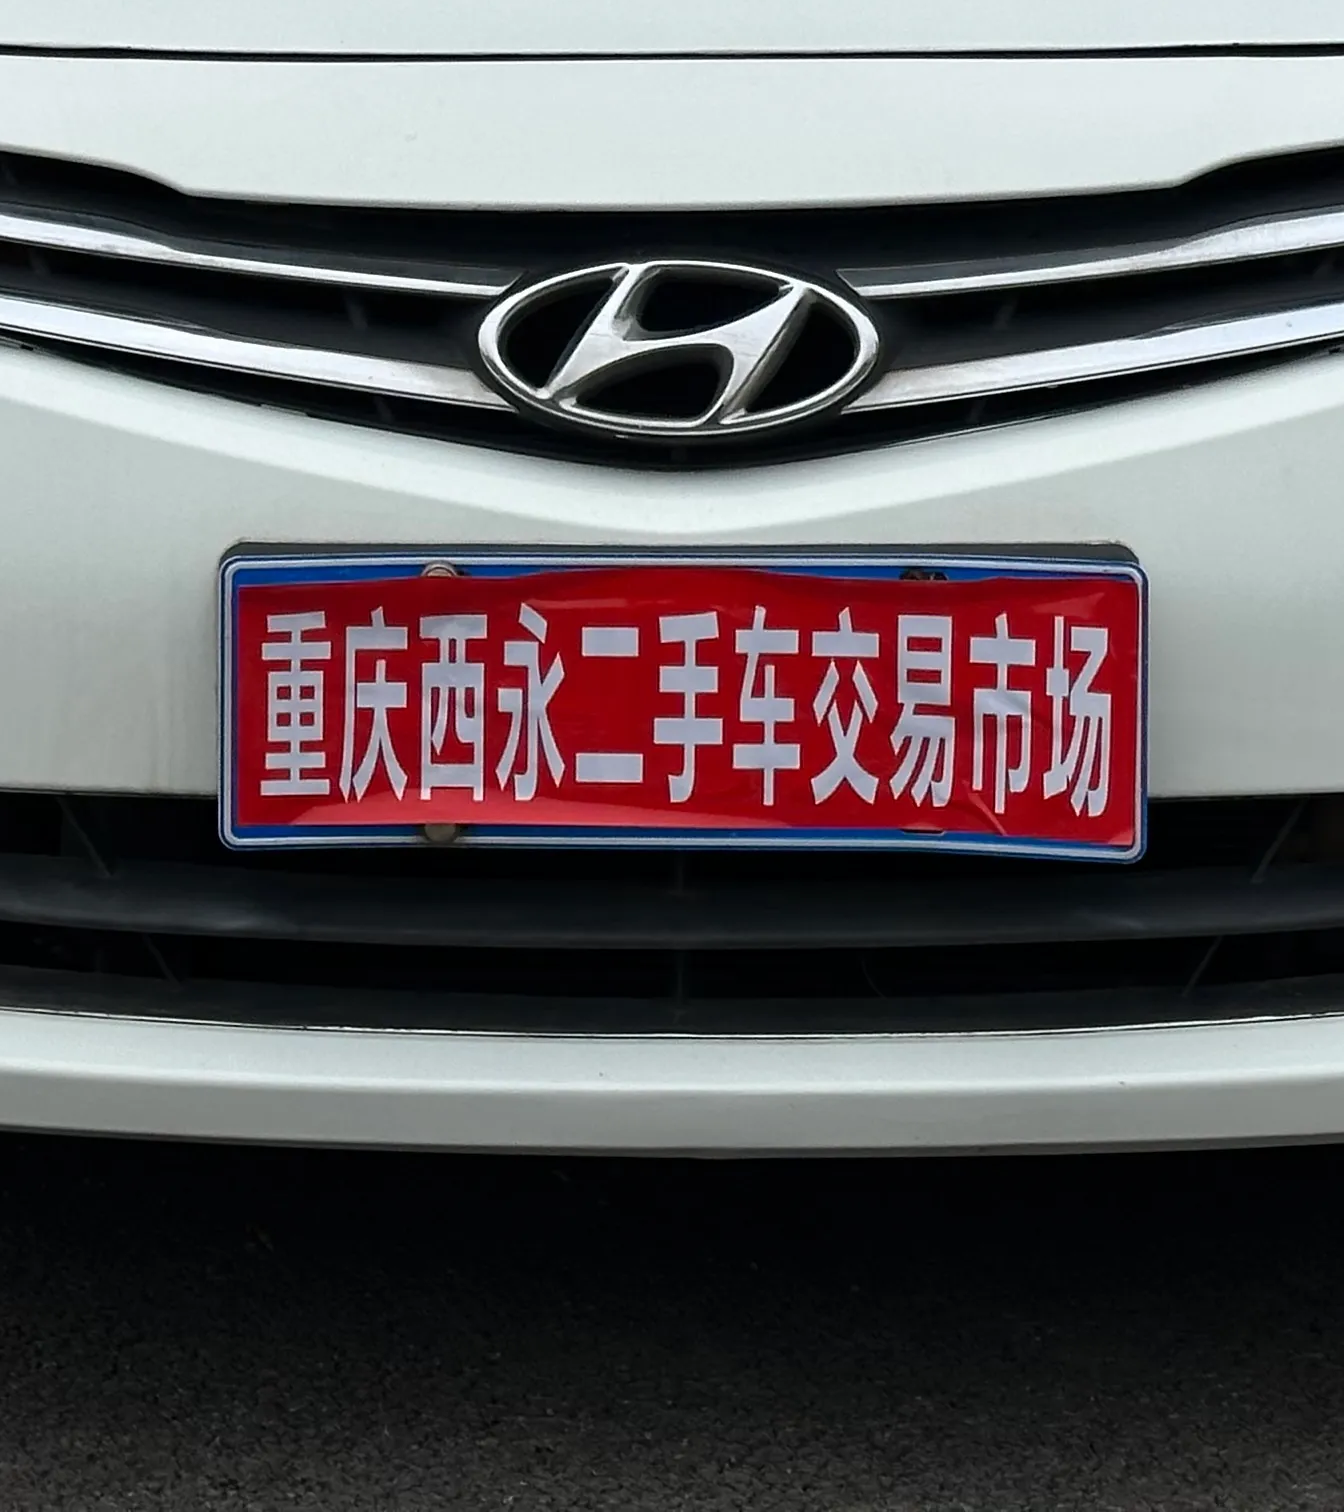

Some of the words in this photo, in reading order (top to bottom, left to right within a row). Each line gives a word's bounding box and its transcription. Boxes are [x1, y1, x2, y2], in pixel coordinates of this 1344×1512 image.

[258, 601, 1114, 818] 重庆西永二手车交易市场
